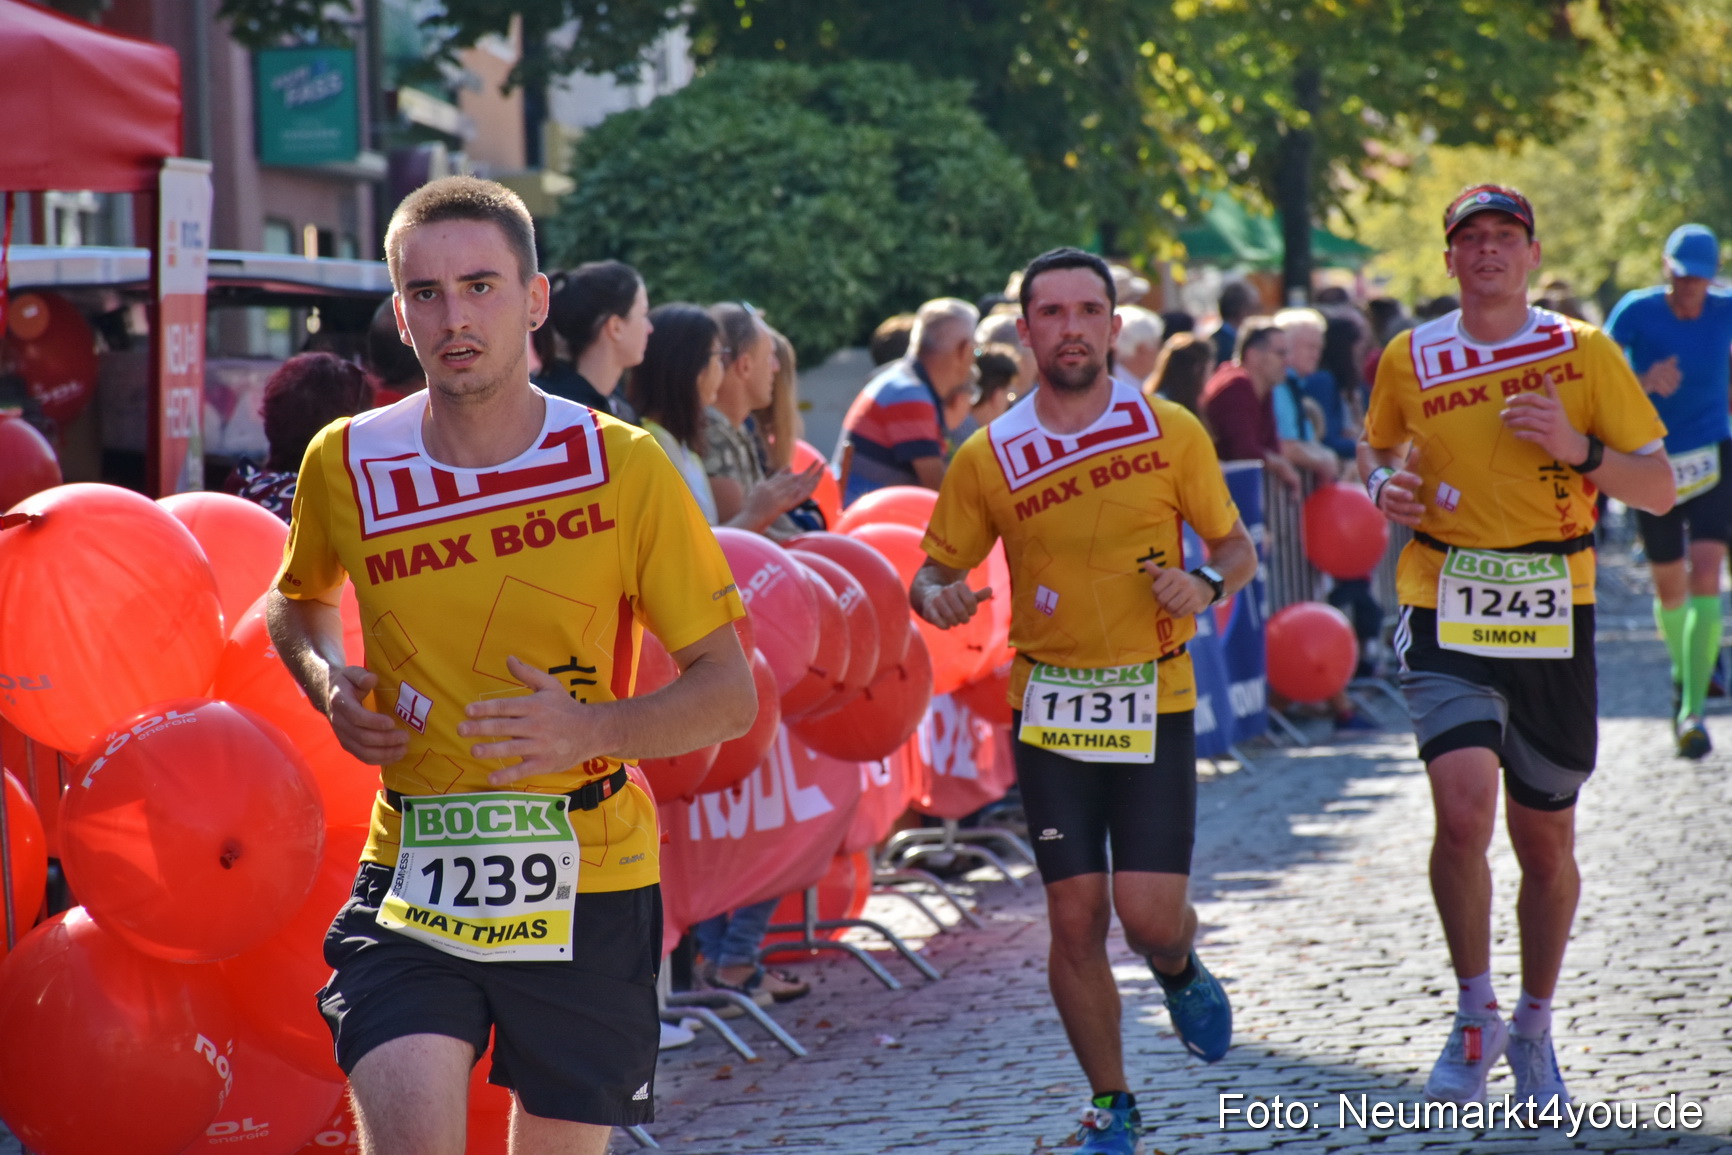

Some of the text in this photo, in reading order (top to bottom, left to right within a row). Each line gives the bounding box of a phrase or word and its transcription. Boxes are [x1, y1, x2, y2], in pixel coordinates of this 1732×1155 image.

[1422, 362, 1584, 419] MAX BÖGL
[1014, 451, 1170, 522] MAX BÖGL
[364, 502, 616, 586] MAX BÖGL
[1454, 553, 1556, 579] BOCK
[1457, 587, 1556, 618] 1243
[1472, 629, 1537, 644] SIMON
[1043, 664, 1142, 685] BOCK
[1042, 692, 1136, 723] 1131
[138, 714, 198, 741] energie
[1041, 731, 1132, 749] MATHIAS
[81, 710, 196, 790] RÖDL
[415, 800, 556, 838] BOCK
[562, 856, 572, 867] C
[421, 853, 557, 907] 1239
[404, 906, 549, 945] MATTHIAS
[208, 1128, 270, 1145] energie
